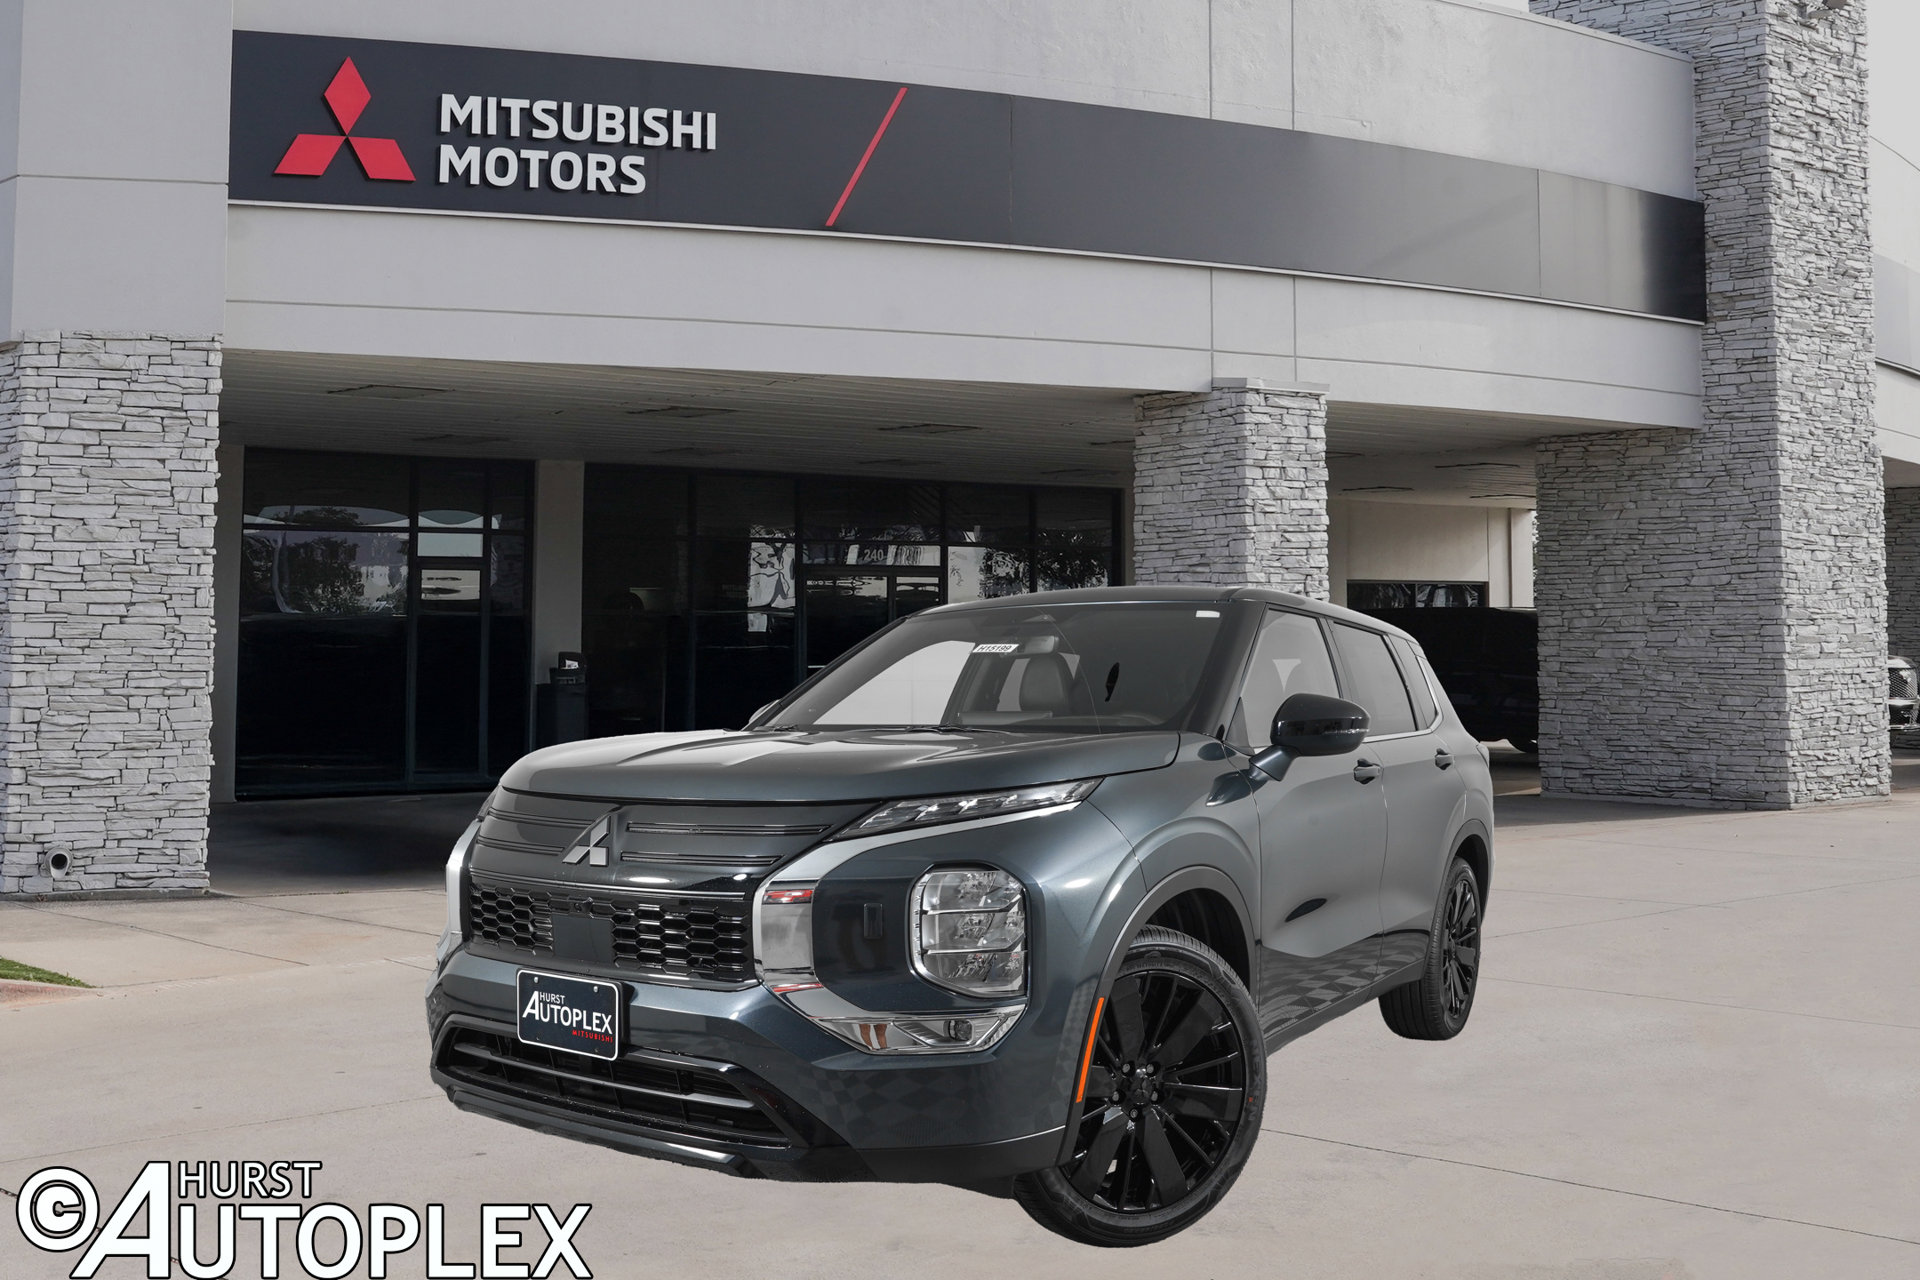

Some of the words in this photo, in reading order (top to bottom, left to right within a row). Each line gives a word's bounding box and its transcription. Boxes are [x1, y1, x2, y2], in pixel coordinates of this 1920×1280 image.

[439, 93, 717, 150] MITSUBISHI
[438, 144, 646, 194] MOTORS
[863, 549, 884, 561] 240
[522, 990, 613, 1035] AUTOPLEX
[540, 991, 565, 1005] HURST
[572, 1030, 613, 1043] MITSUBISHI
[1247, 1039, 1262, 1121] NEXEN
